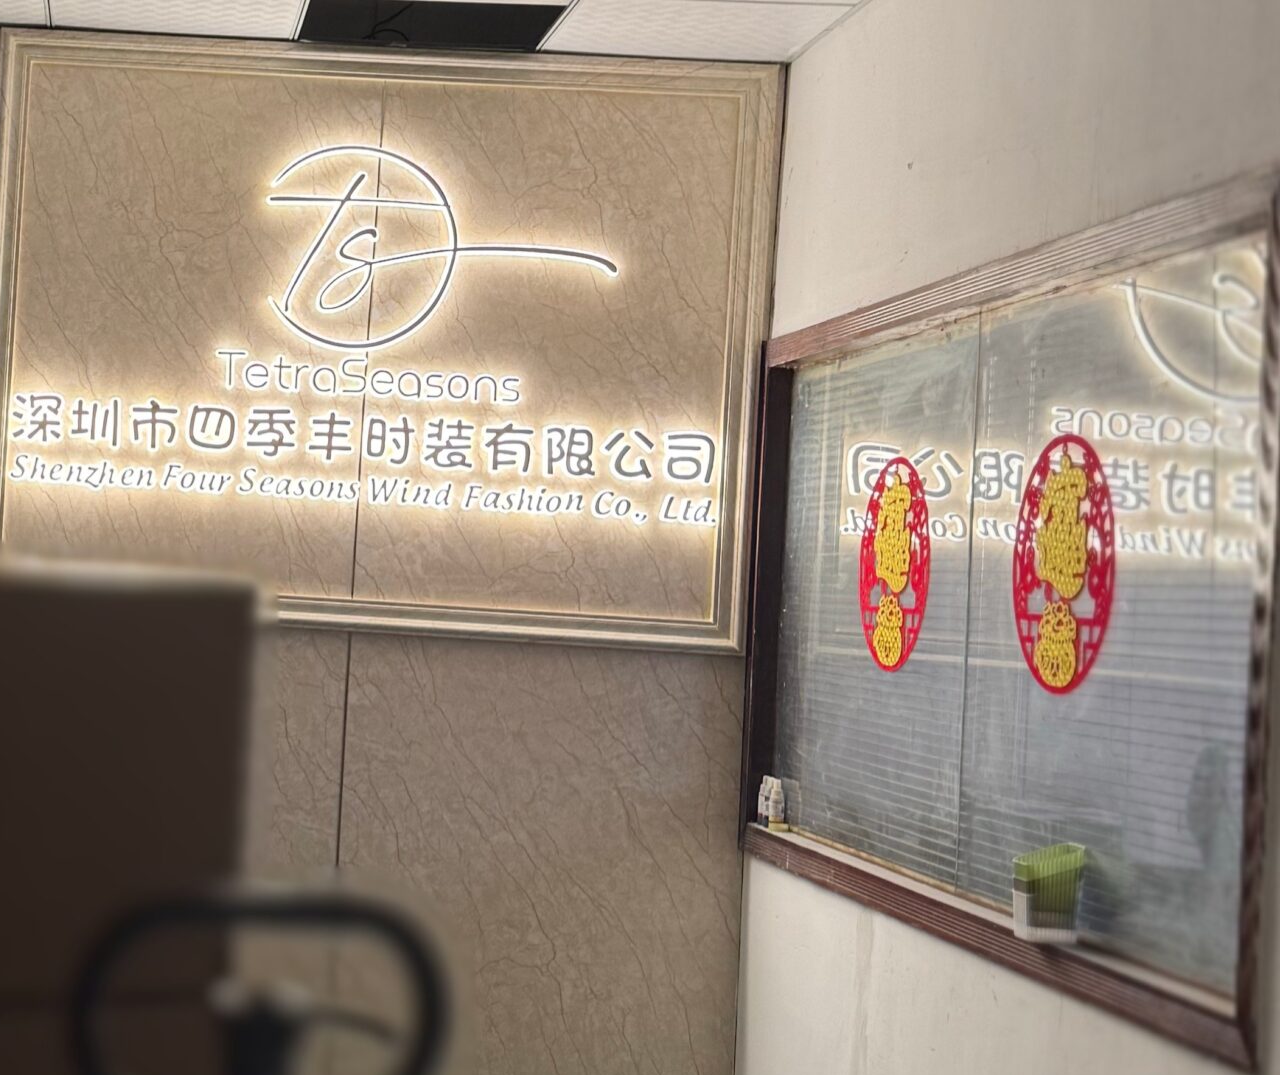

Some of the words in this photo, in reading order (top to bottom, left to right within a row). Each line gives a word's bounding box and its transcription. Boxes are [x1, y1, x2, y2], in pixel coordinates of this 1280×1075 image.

[218, 350, 520, 402] TetraSeasons
[12, 393, 716, 484] 深圳市四季丰时装有限公司
[10, 454, 153, 488] Shenzhen
[163, 464, 232, 492] Four
[239, 467, 360, 499] Seasons
[370, 477, 452, 505] Wind
[464, 484, 584, 513] Fashion
[594, 490, 648, 522] Co.,
[663, 496, 717, 523] Ltd.
